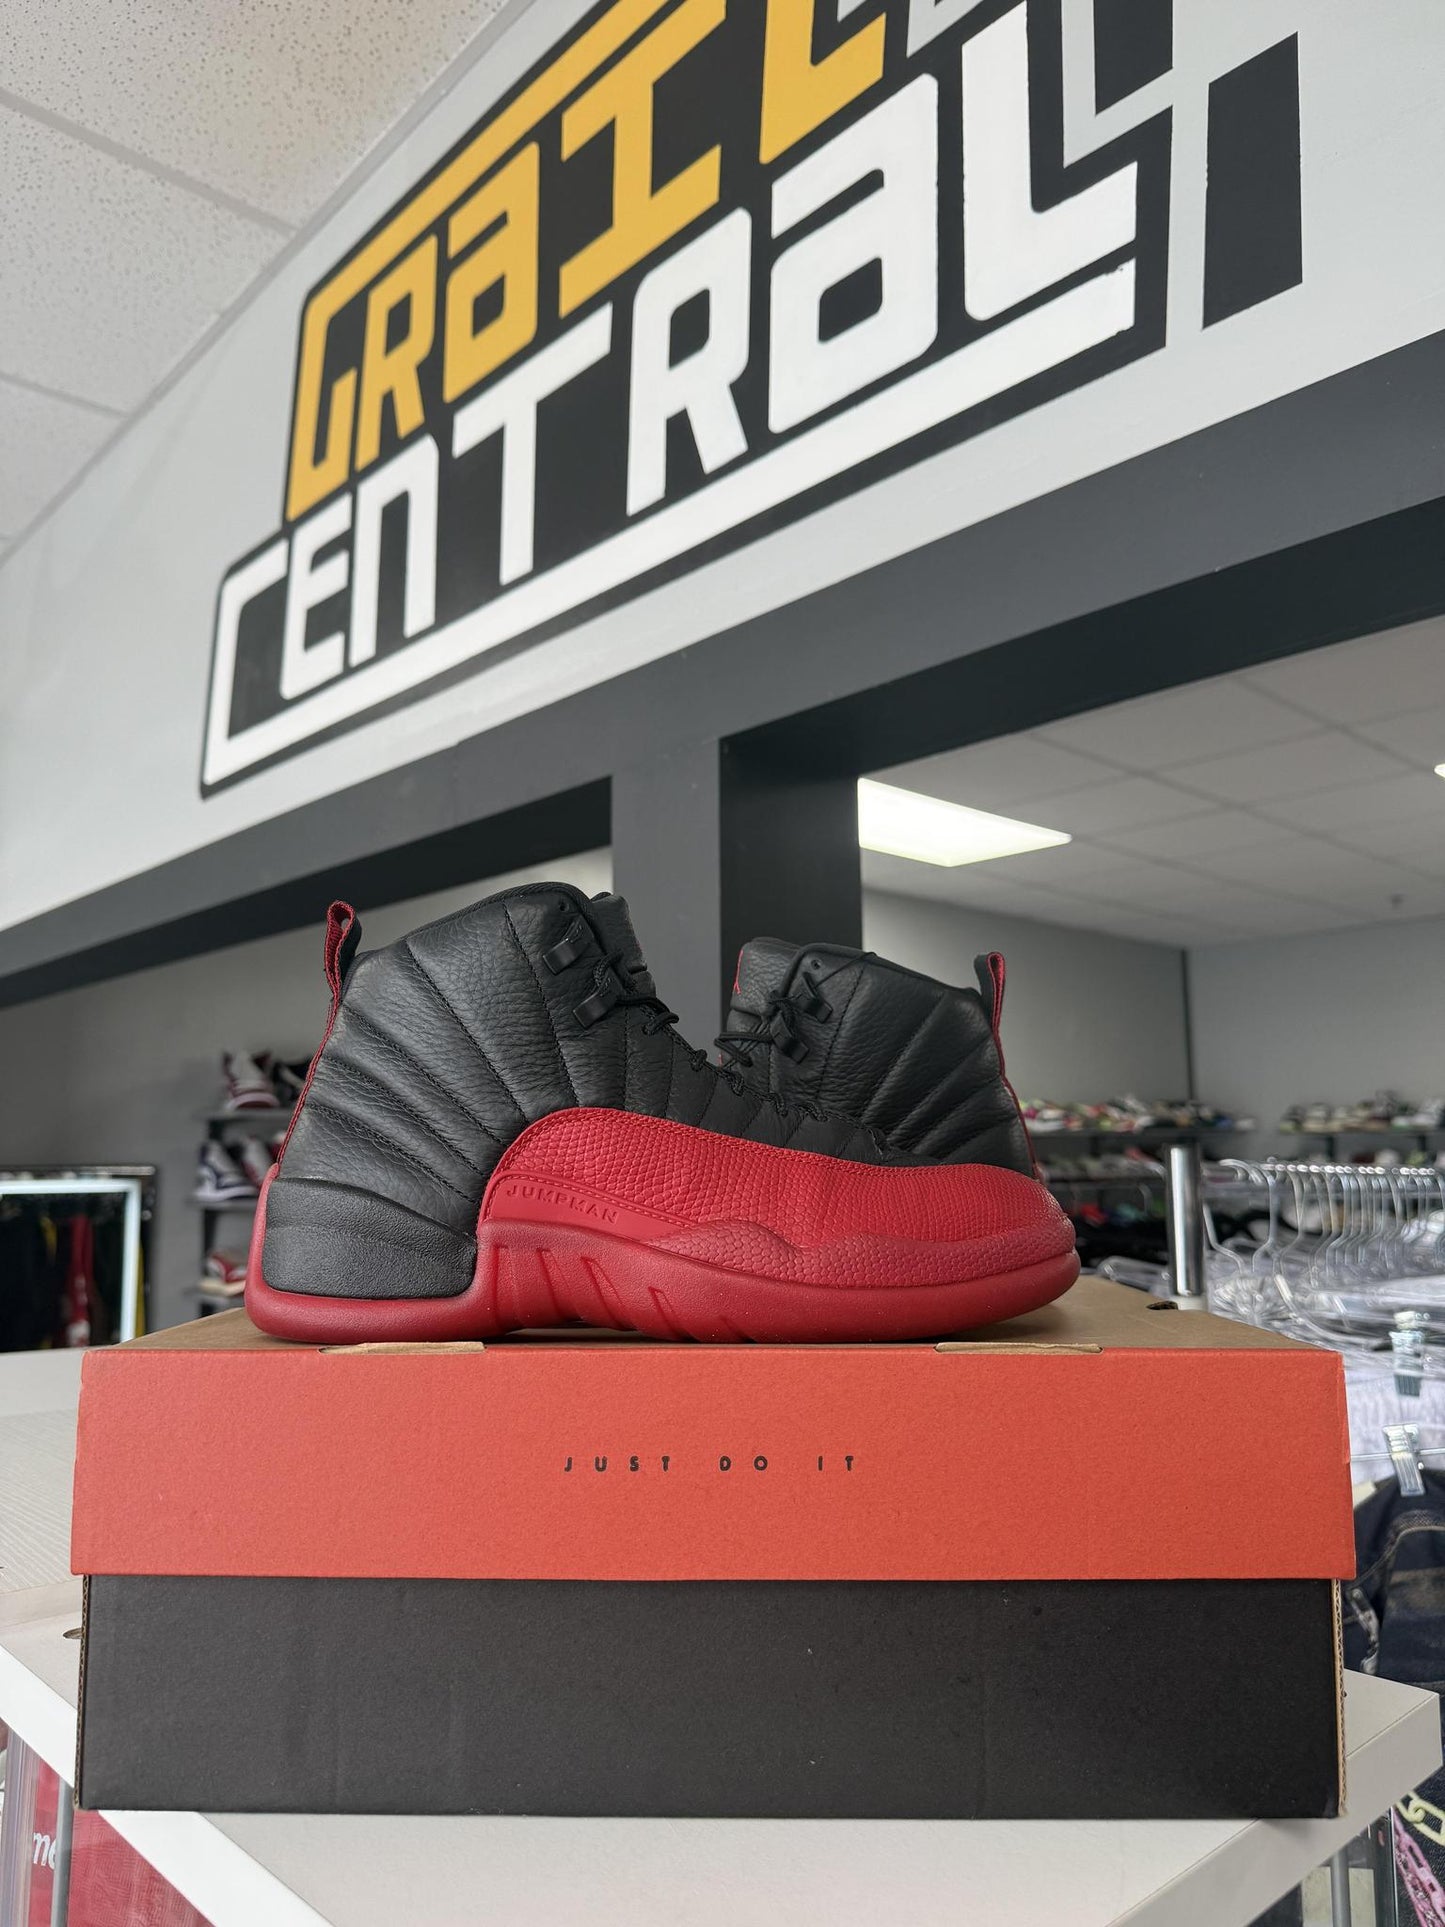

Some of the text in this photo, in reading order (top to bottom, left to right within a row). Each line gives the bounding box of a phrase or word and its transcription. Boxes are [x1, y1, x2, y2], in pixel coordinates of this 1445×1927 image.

[506, 1184, 618, 1225] JUMPMAN
[564, 1455, 854, 1472] JUST DO IT
